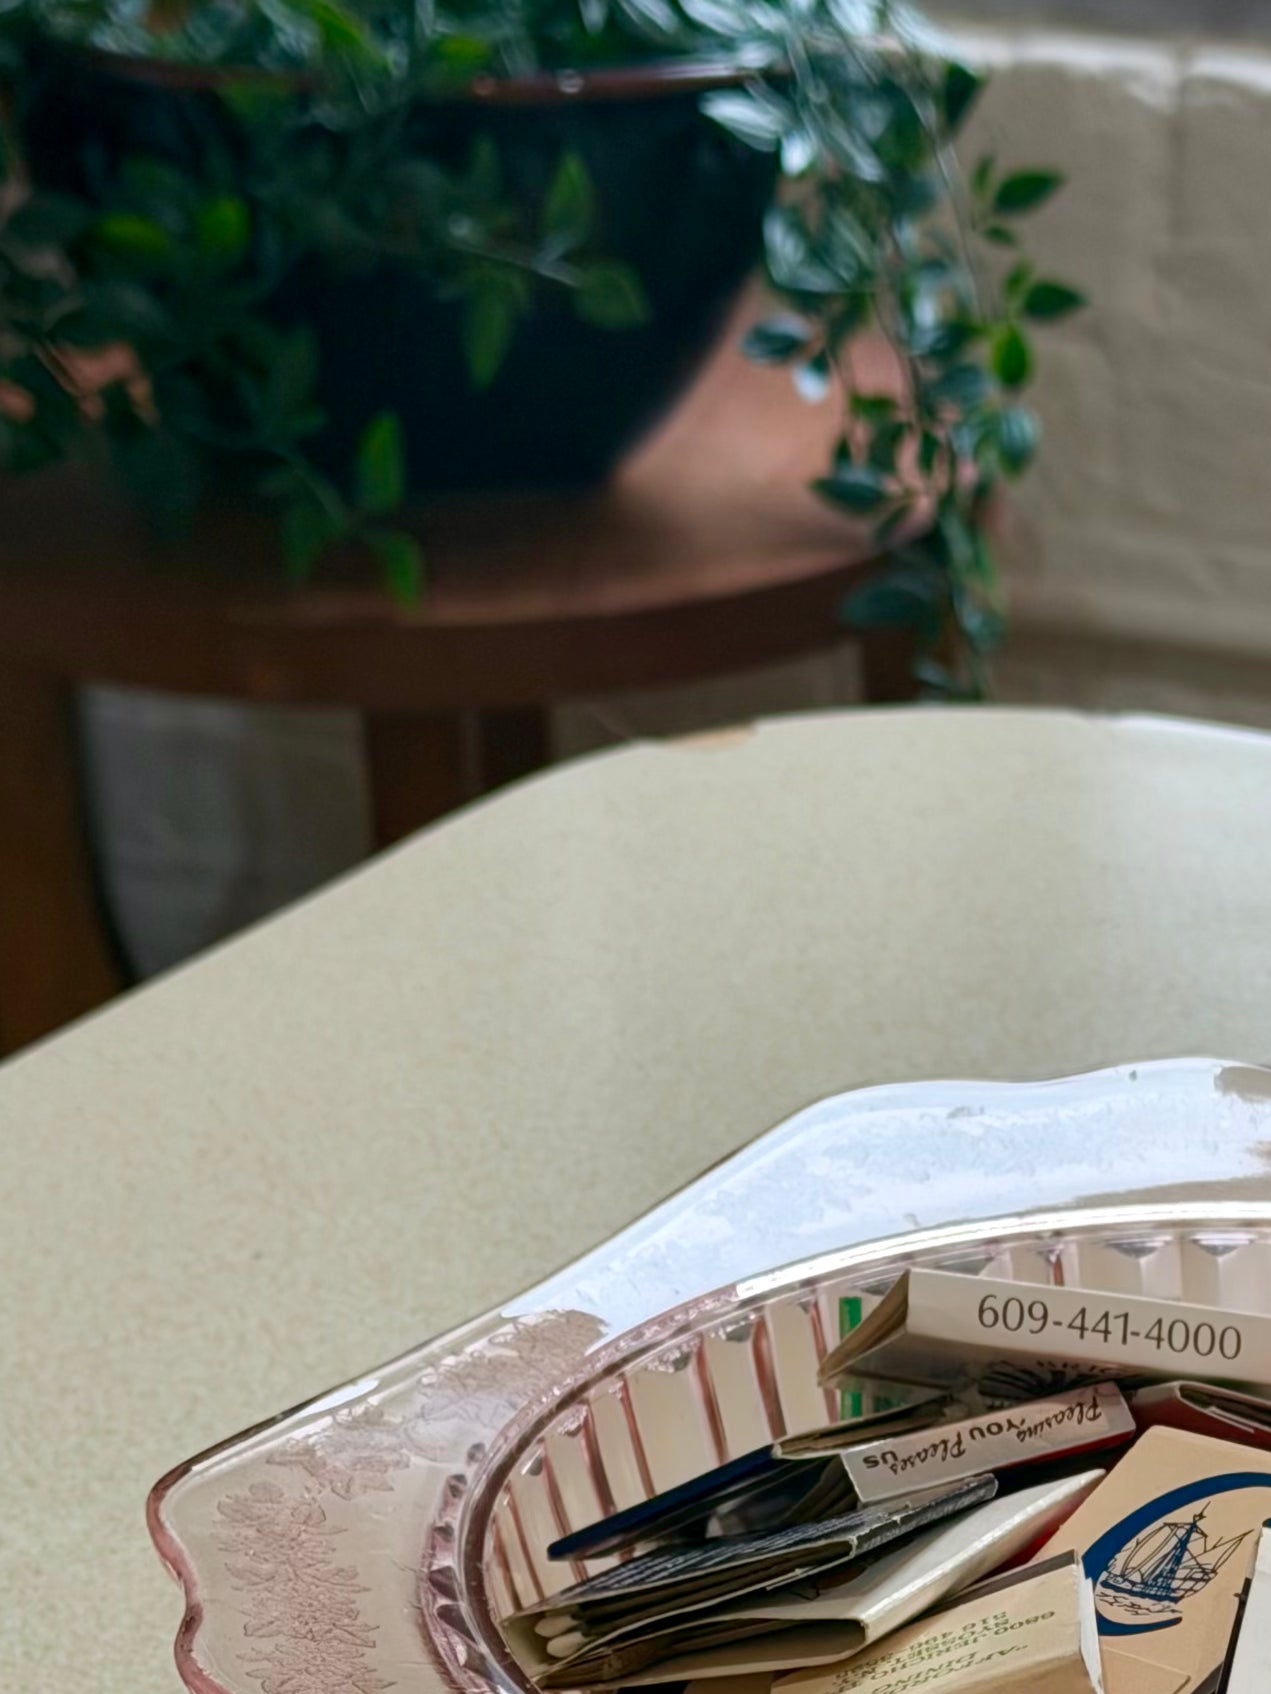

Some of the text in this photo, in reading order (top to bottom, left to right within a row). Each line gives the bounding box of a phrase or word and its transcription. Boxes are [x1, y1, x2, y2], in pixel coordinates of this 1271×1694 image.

[977, 1294, 1242, 1360] 609-441-4000
[862, 1396, 1102, 1476] Pleasing YOU Pleases US
